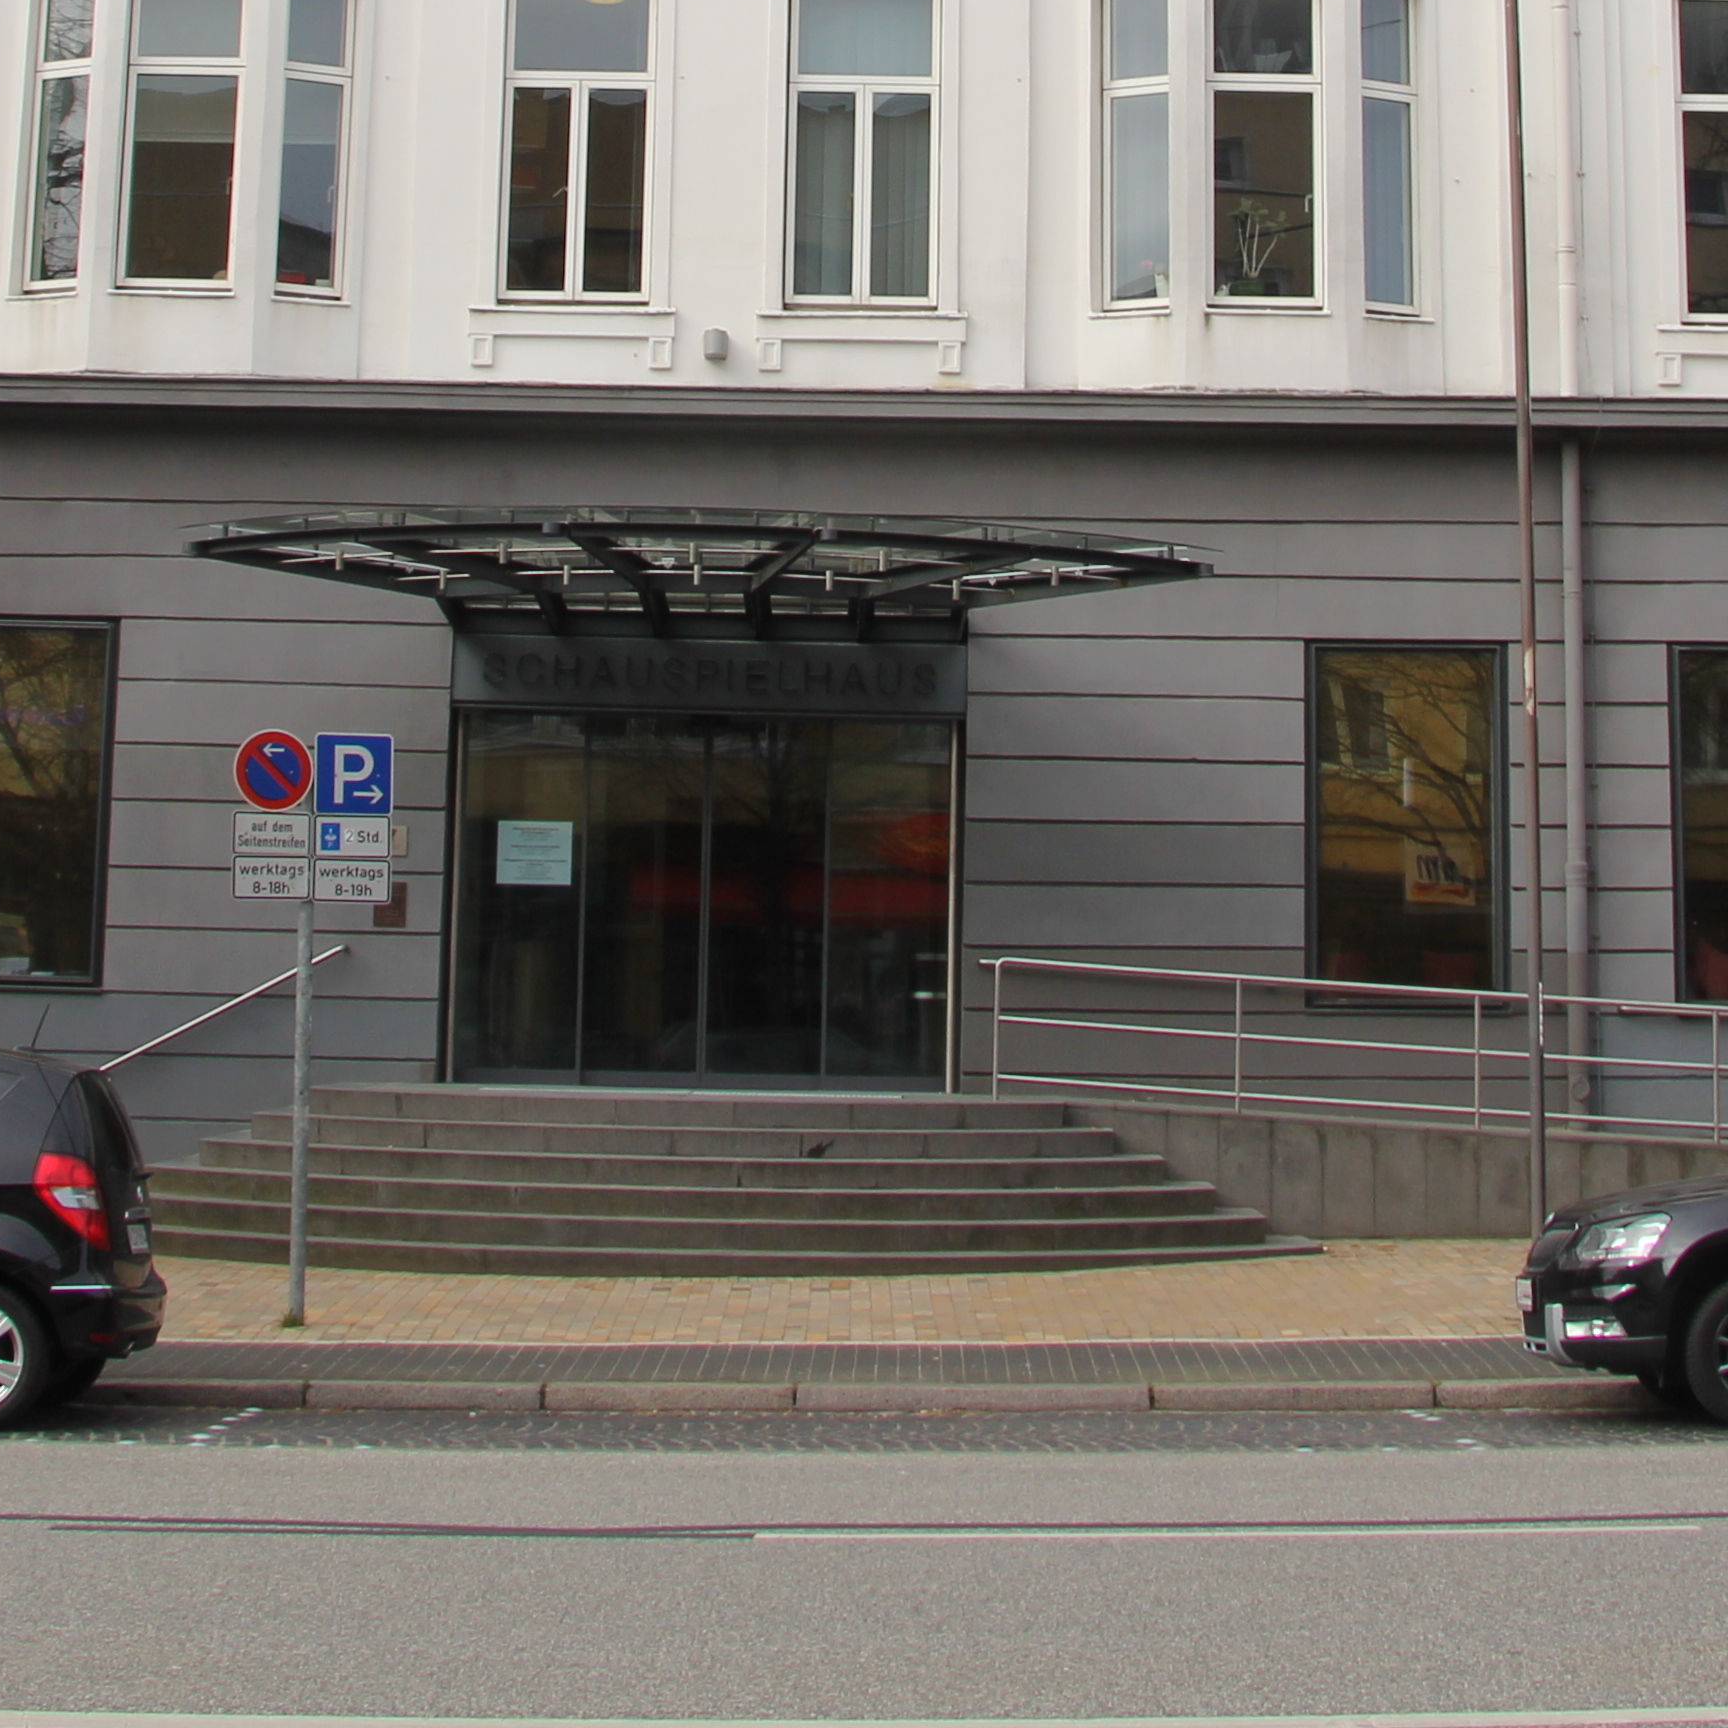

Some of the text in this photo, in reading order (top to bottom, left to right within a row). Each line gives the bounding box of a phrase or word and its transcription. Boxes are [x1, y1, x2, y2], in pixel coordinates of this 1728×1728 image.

[482, 652, 937, 697] SCHAUSPIELHAUS
[333, 744, 375, 804] P
[251, 820, 293, 833] auf dem
[238, 833, 306, 849] Seitenstreifen
[345, 829, 383, 843] 2 Std.
[239, 863, 304, 879] werktags
[318, 866, 384, 881] werktags
[252, 881, 290, 895] 8-18h
[335, 883, 373, 897] 8-19h
